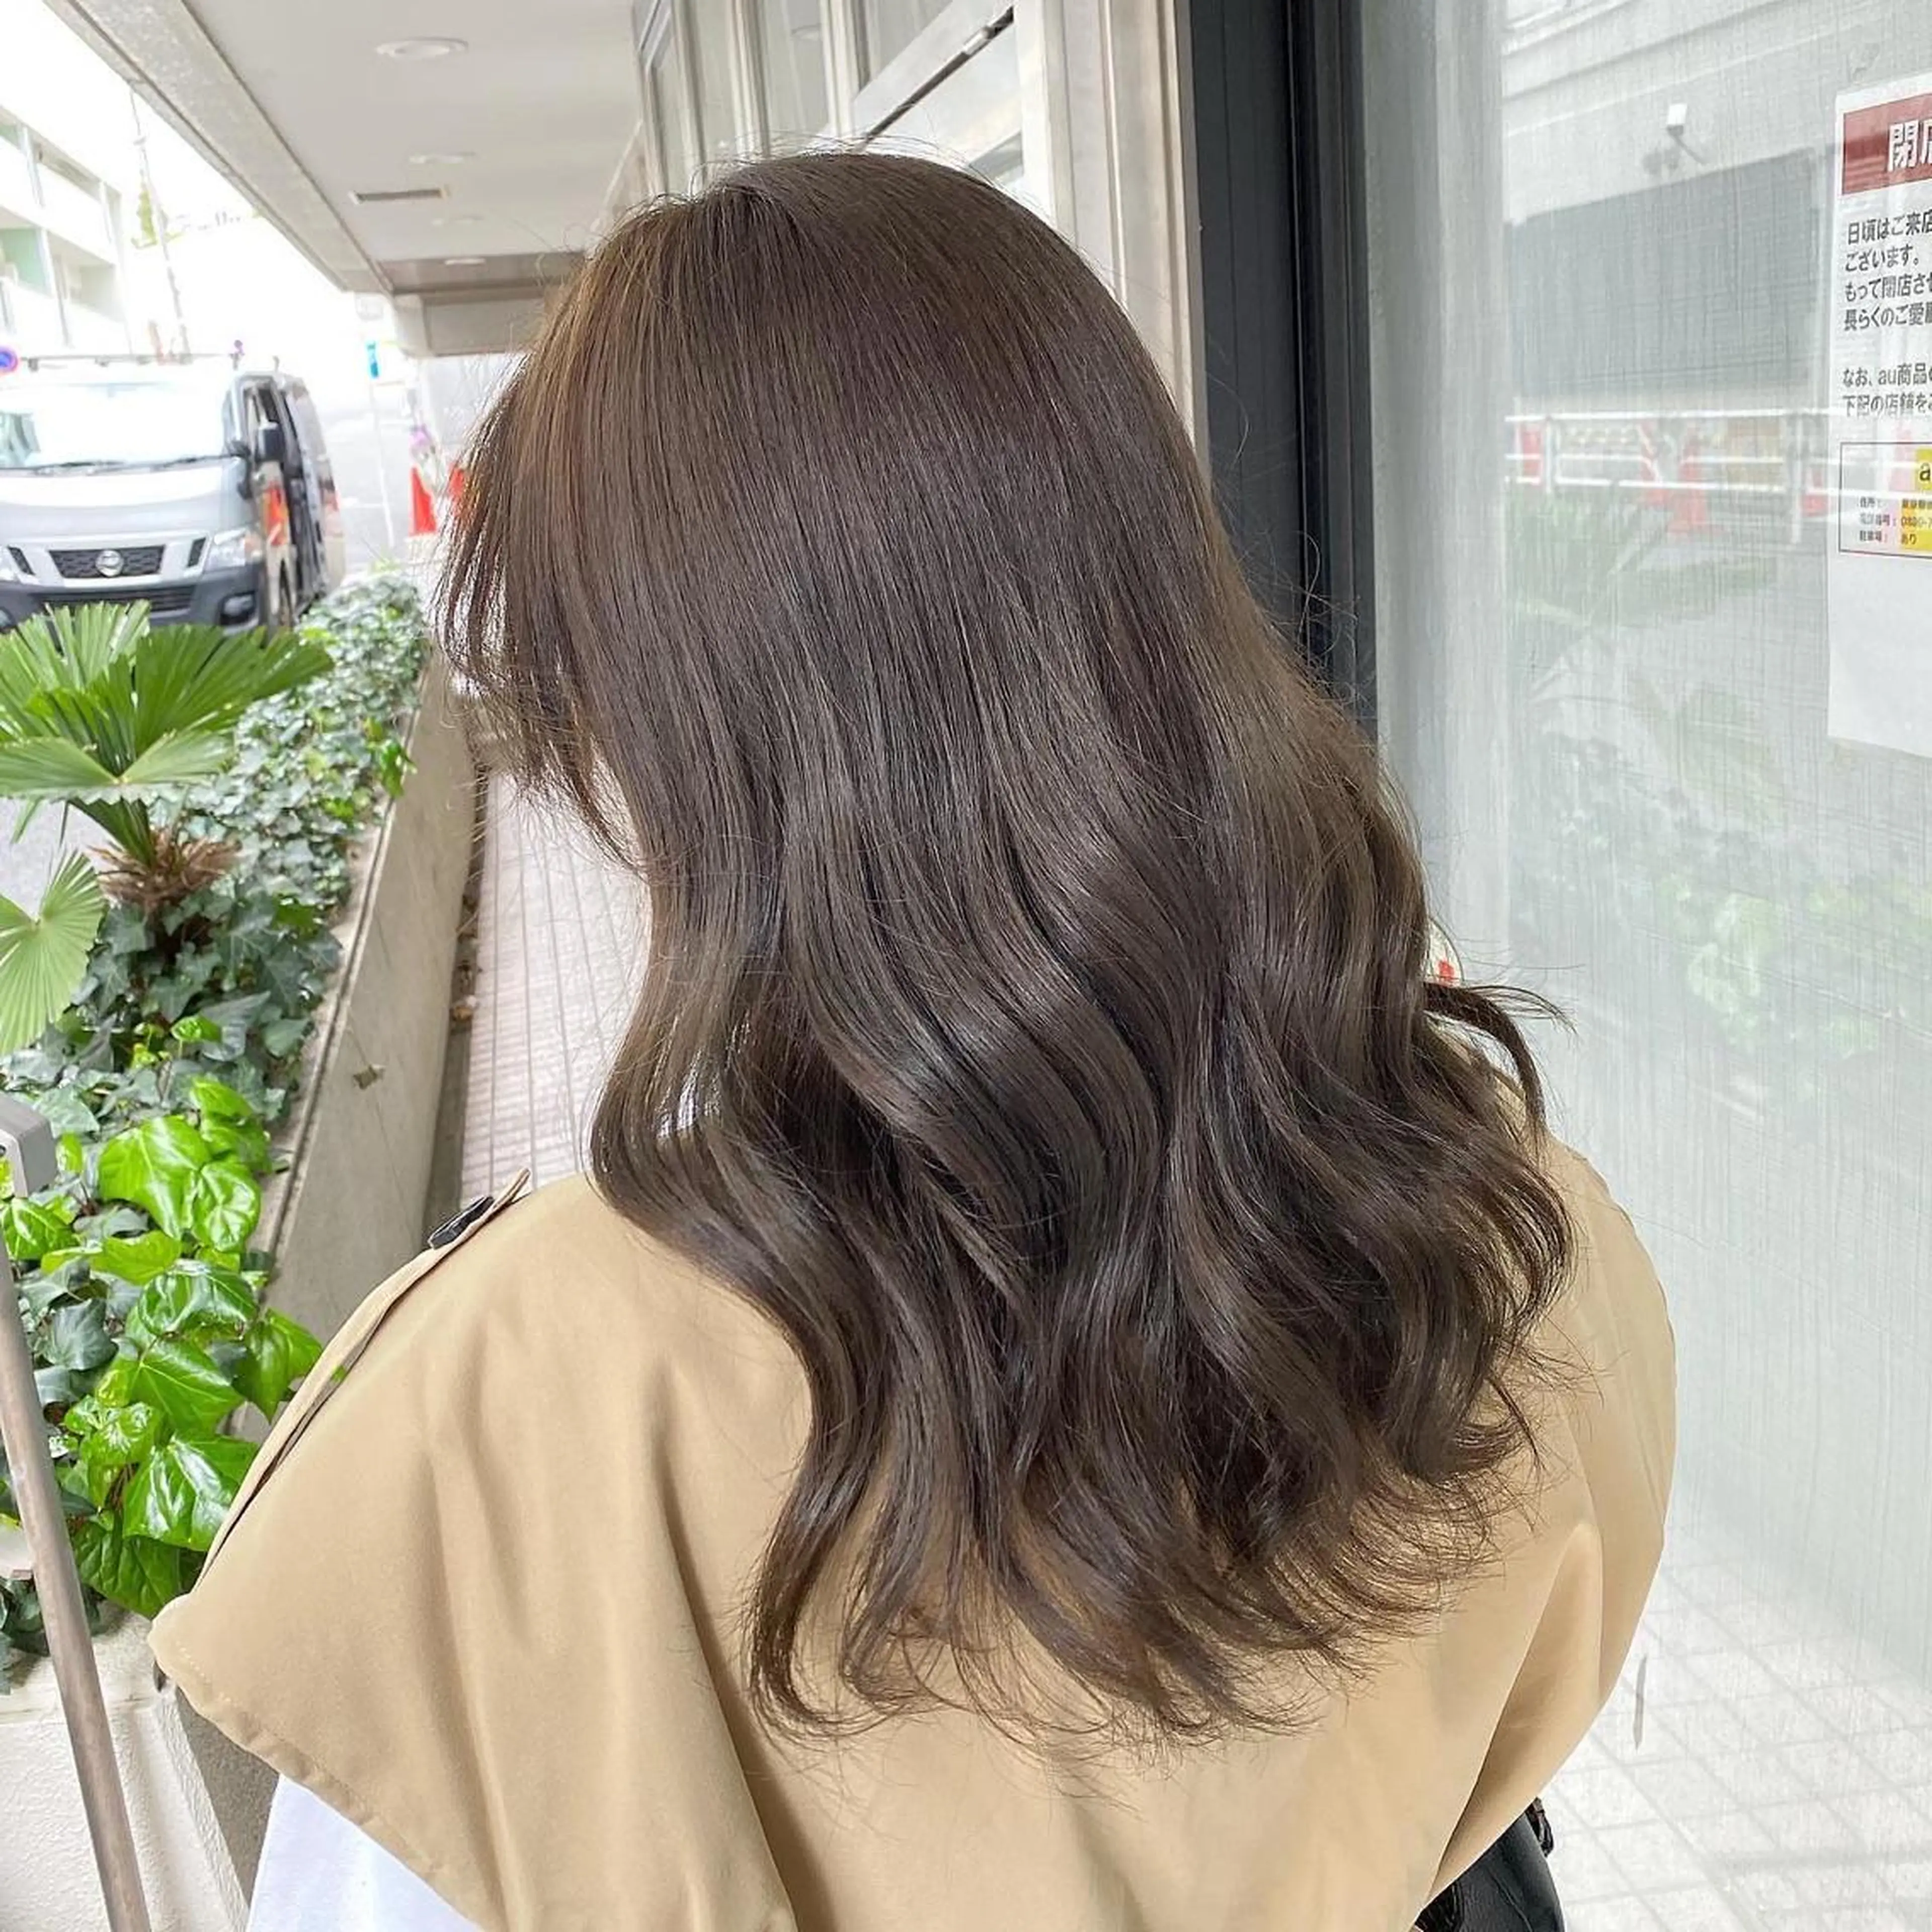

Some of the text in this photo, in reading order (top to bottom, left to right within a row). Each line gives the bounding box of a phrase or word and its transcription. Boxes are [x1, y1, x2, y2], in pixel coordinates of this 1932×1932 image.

[1845, 244, 1919, 271] ございます。
[1843, 362, 1932, 386] なお、au商品
